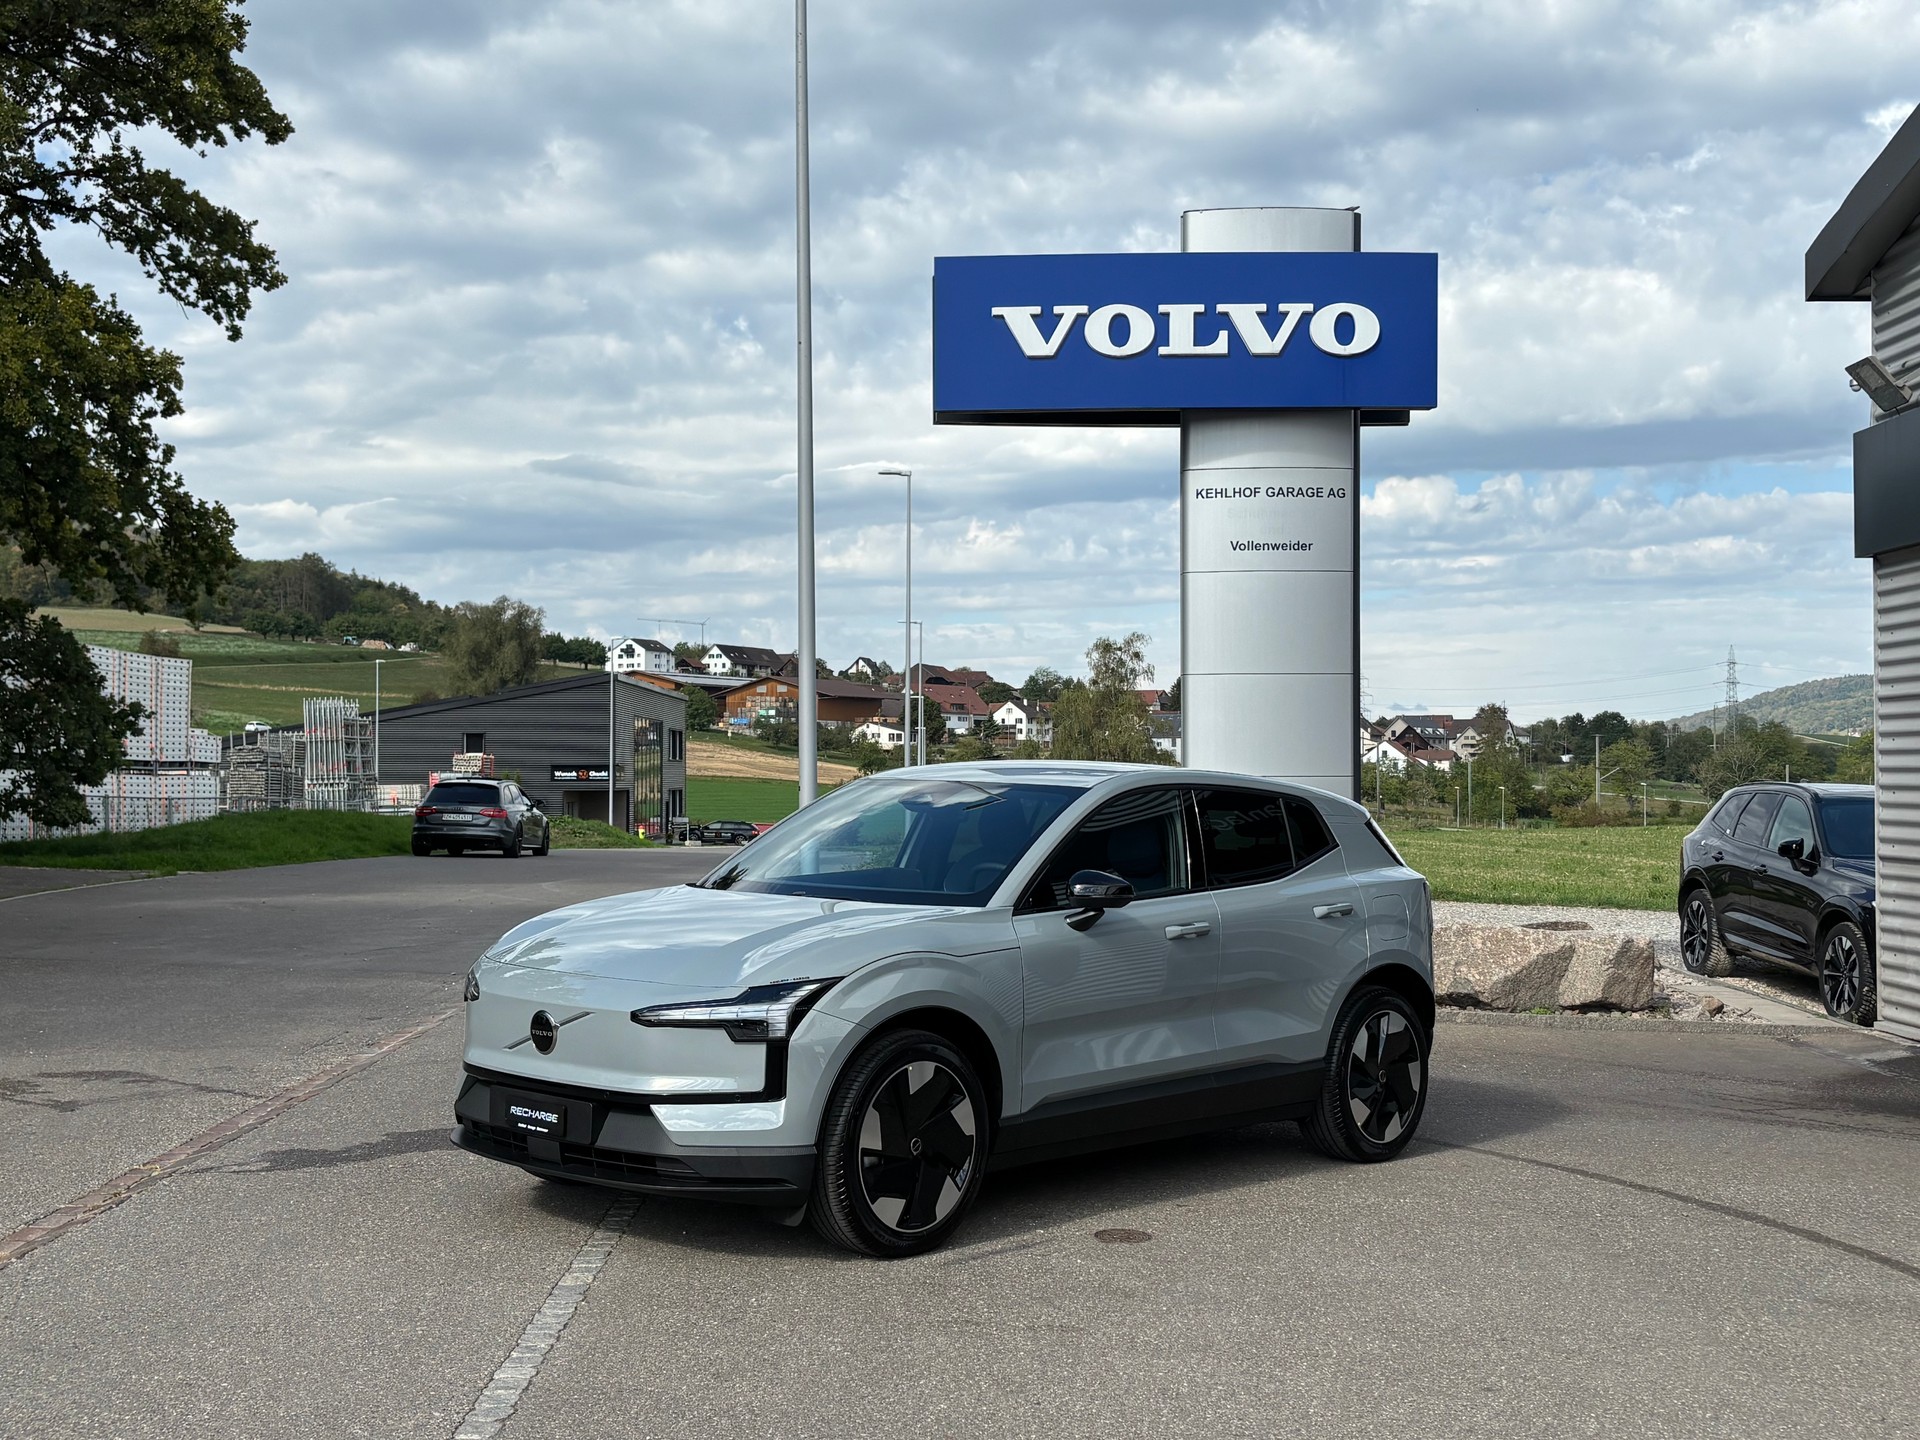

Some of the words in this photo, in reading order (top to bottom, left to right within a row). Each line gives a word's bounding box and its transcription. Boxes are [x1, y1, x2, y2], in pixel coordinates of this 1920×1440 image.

[991, 302, 1381, 358] VOLVO
[1195, 487, 1262, 499] KEHLHOF
[1265, 487, 1324, 498] GARAGE
[1327, 488, 1346, 499] AG
[1230, 540, 1314, 552] Vollenweider
[532, 1029, 553, 1037] VOLVO
[510, 1105, 559, 1123] RECHARGE
